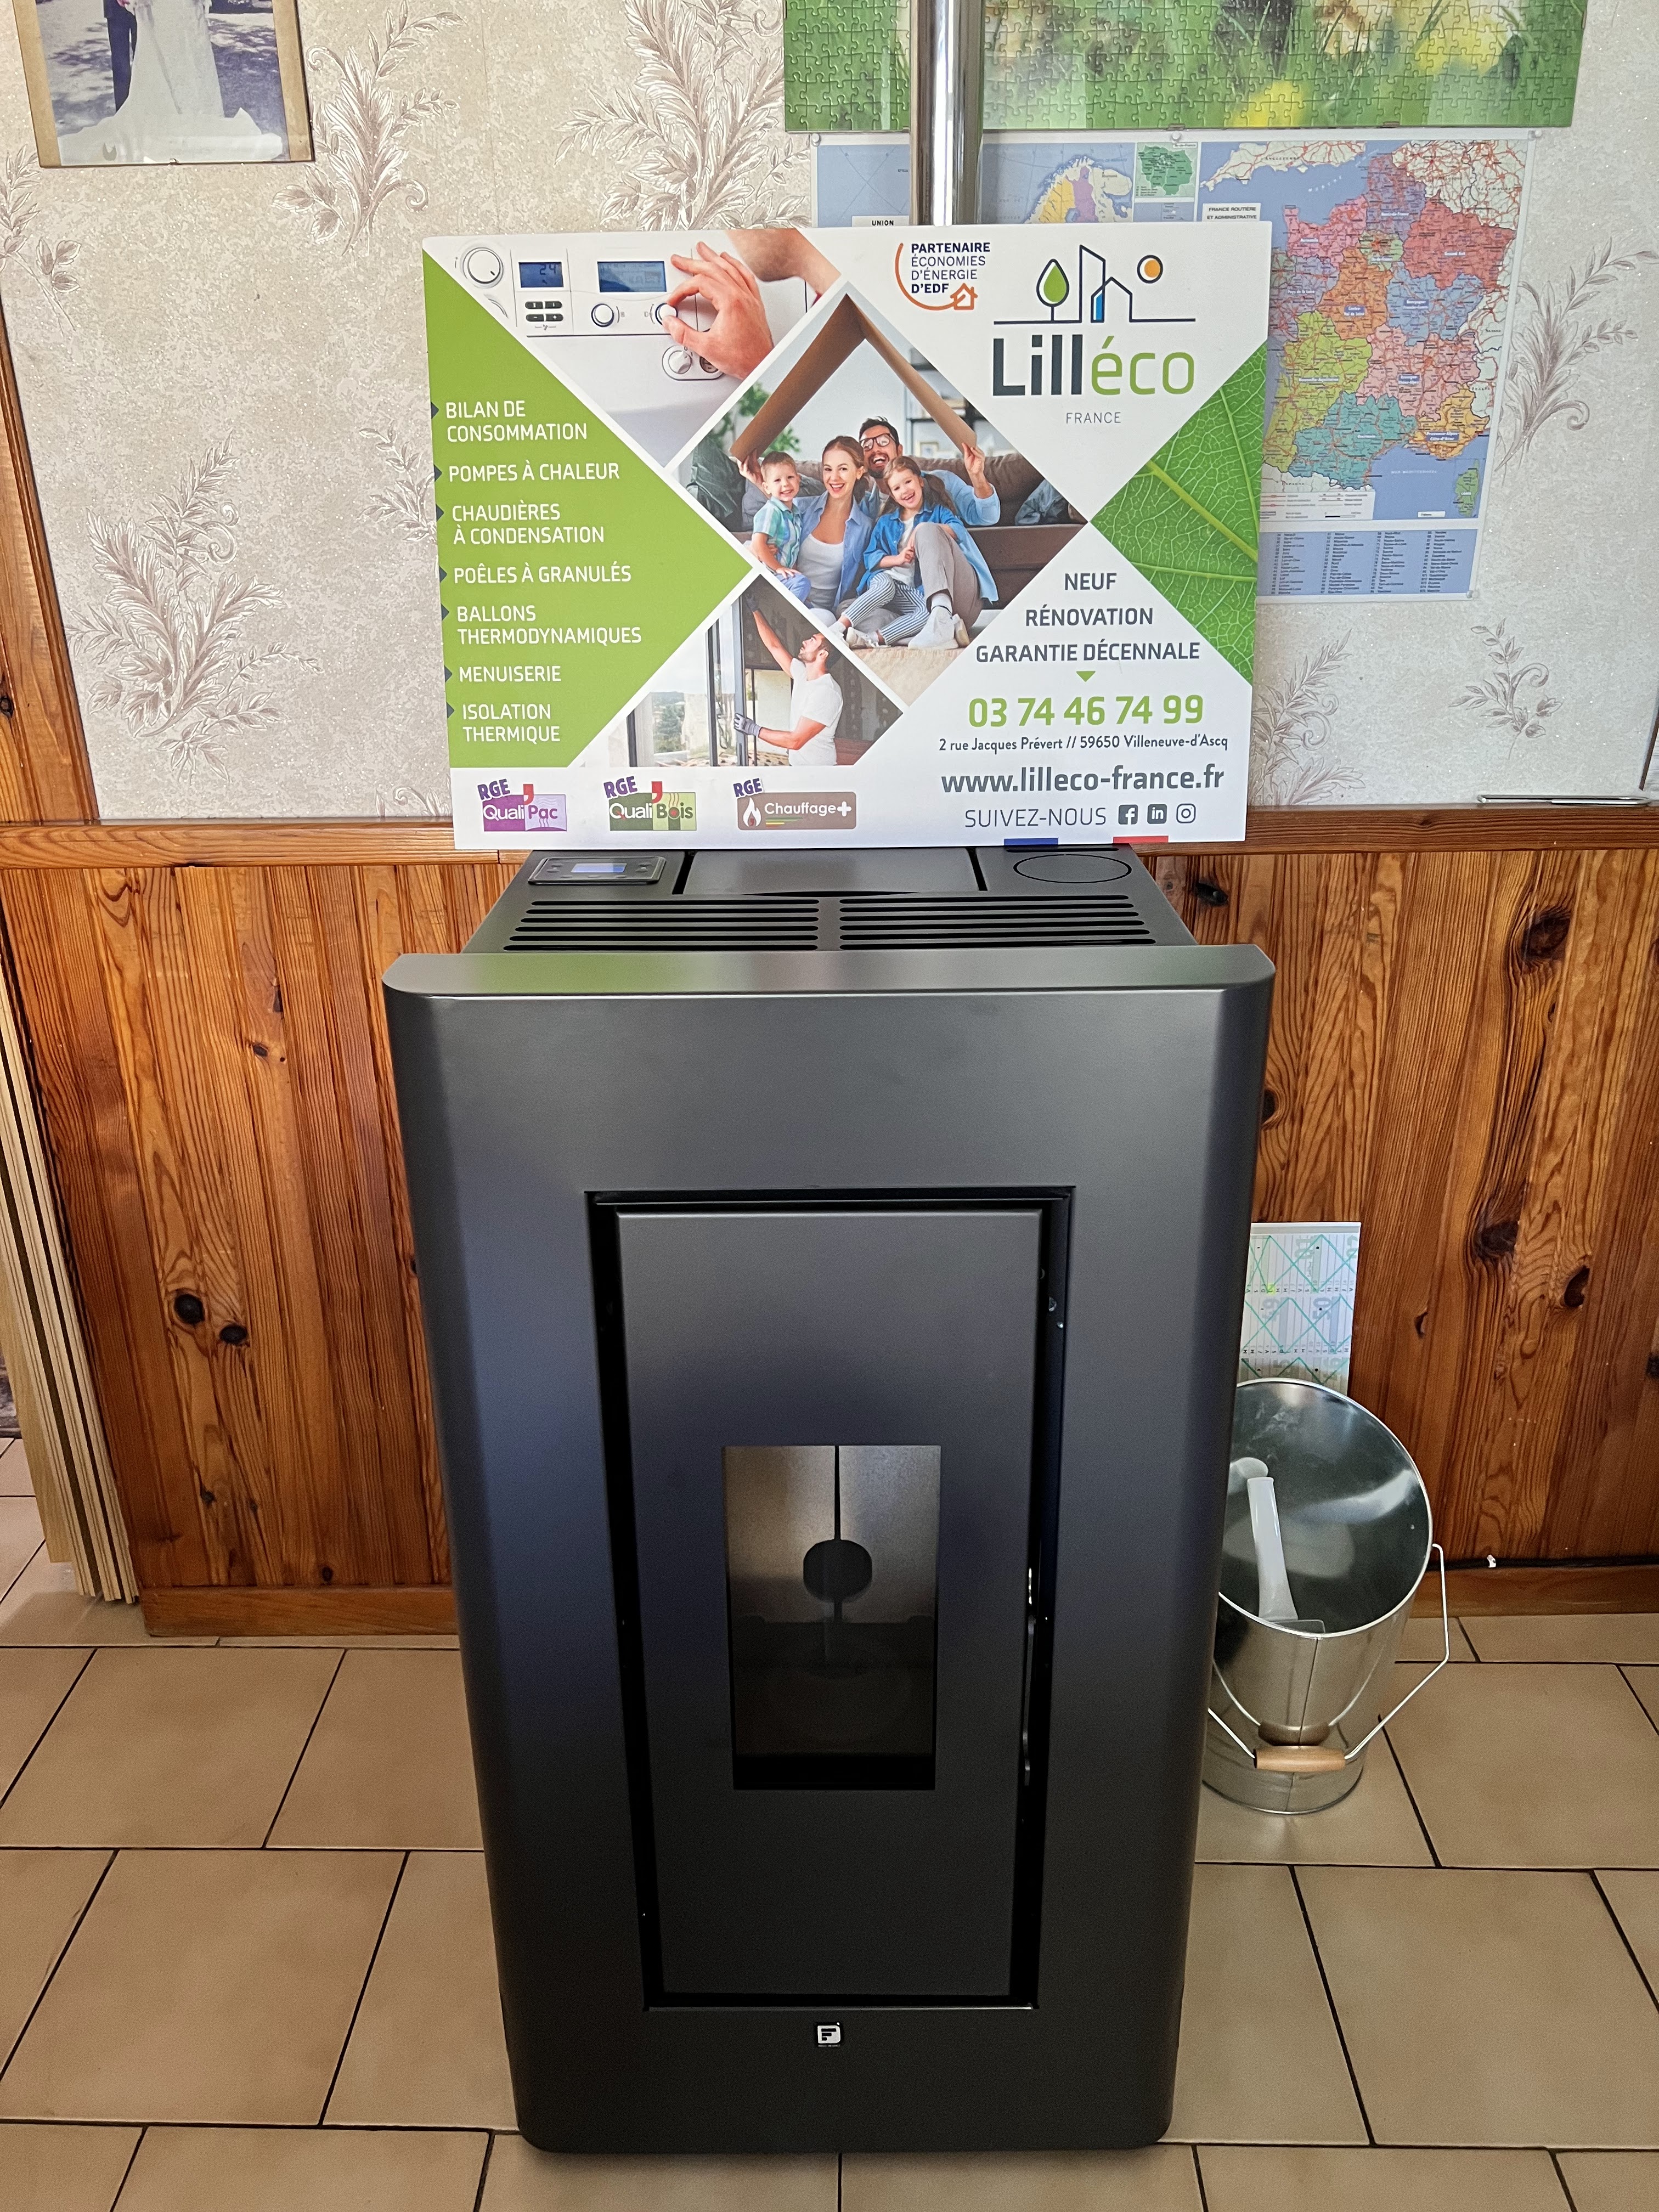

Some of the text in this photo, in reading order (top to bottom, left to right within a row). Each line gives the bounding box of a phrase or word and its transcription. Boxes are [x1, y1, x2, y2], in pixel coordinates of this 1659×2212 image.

[911, 242, 991, 253] PARTENAIRE
[911, 254, 986, 267] ÉCONOMIES
[911, 267, 978, 280] D'ÉNERGIE
[911, 283, 949, 294] D'EDF
[993, 334, 1195, 396] Lilléco
[445, 400, 526, 419] BILAN DE
[1066, 411, 1121, 424] FRANCE
[447, 422, 588, 442] CONSOMMATION
[449, 459, 620, 482] POMPES À CHALEUR
[452, 499, 561, 522] CHAUDIÈRES
[453, 524, 605, 545] À CONDENSATION
[454, 561, 632, 584] POÊLES À GRANULÉS
[1064, 572, 1117, 590] NEUF
[456, 605, 537, 623] BALLONS
[1026, 604, 1153, 627] RÉNOVATION
[456, 626, 642, 646] THERMODYNAMIQUES
[977, 638, 1200, 663] GARANTIE DÉCENNALE
[458, 664, 562, 683] MENUISERIE
[461, 703, 552, 720] ISOLATION
[969, 695, 1204, 727] 03 74 46 74 99
[462, 725, 561, 744] THERMIQUE
[939, 738, 946, 751] 2
[950, 742, 969, 751] rue
[971, 738, 1017, 755] Jacques
[1021, 737, 1063, 749] Prévert
[1080, 736, 1120, 748] 59650
[1124, 733, 1228, 751] Villeneuve-d'Ascq
[603, 776, 637, 798] RGE
[733, 777, 763, 798] RGE
[941, 763, 1224, 793] www.lilleco-france.fr
[478, 778, 510, 800] RGE
[964, 807, 1106, 827] SUIVEZ-NOUS
